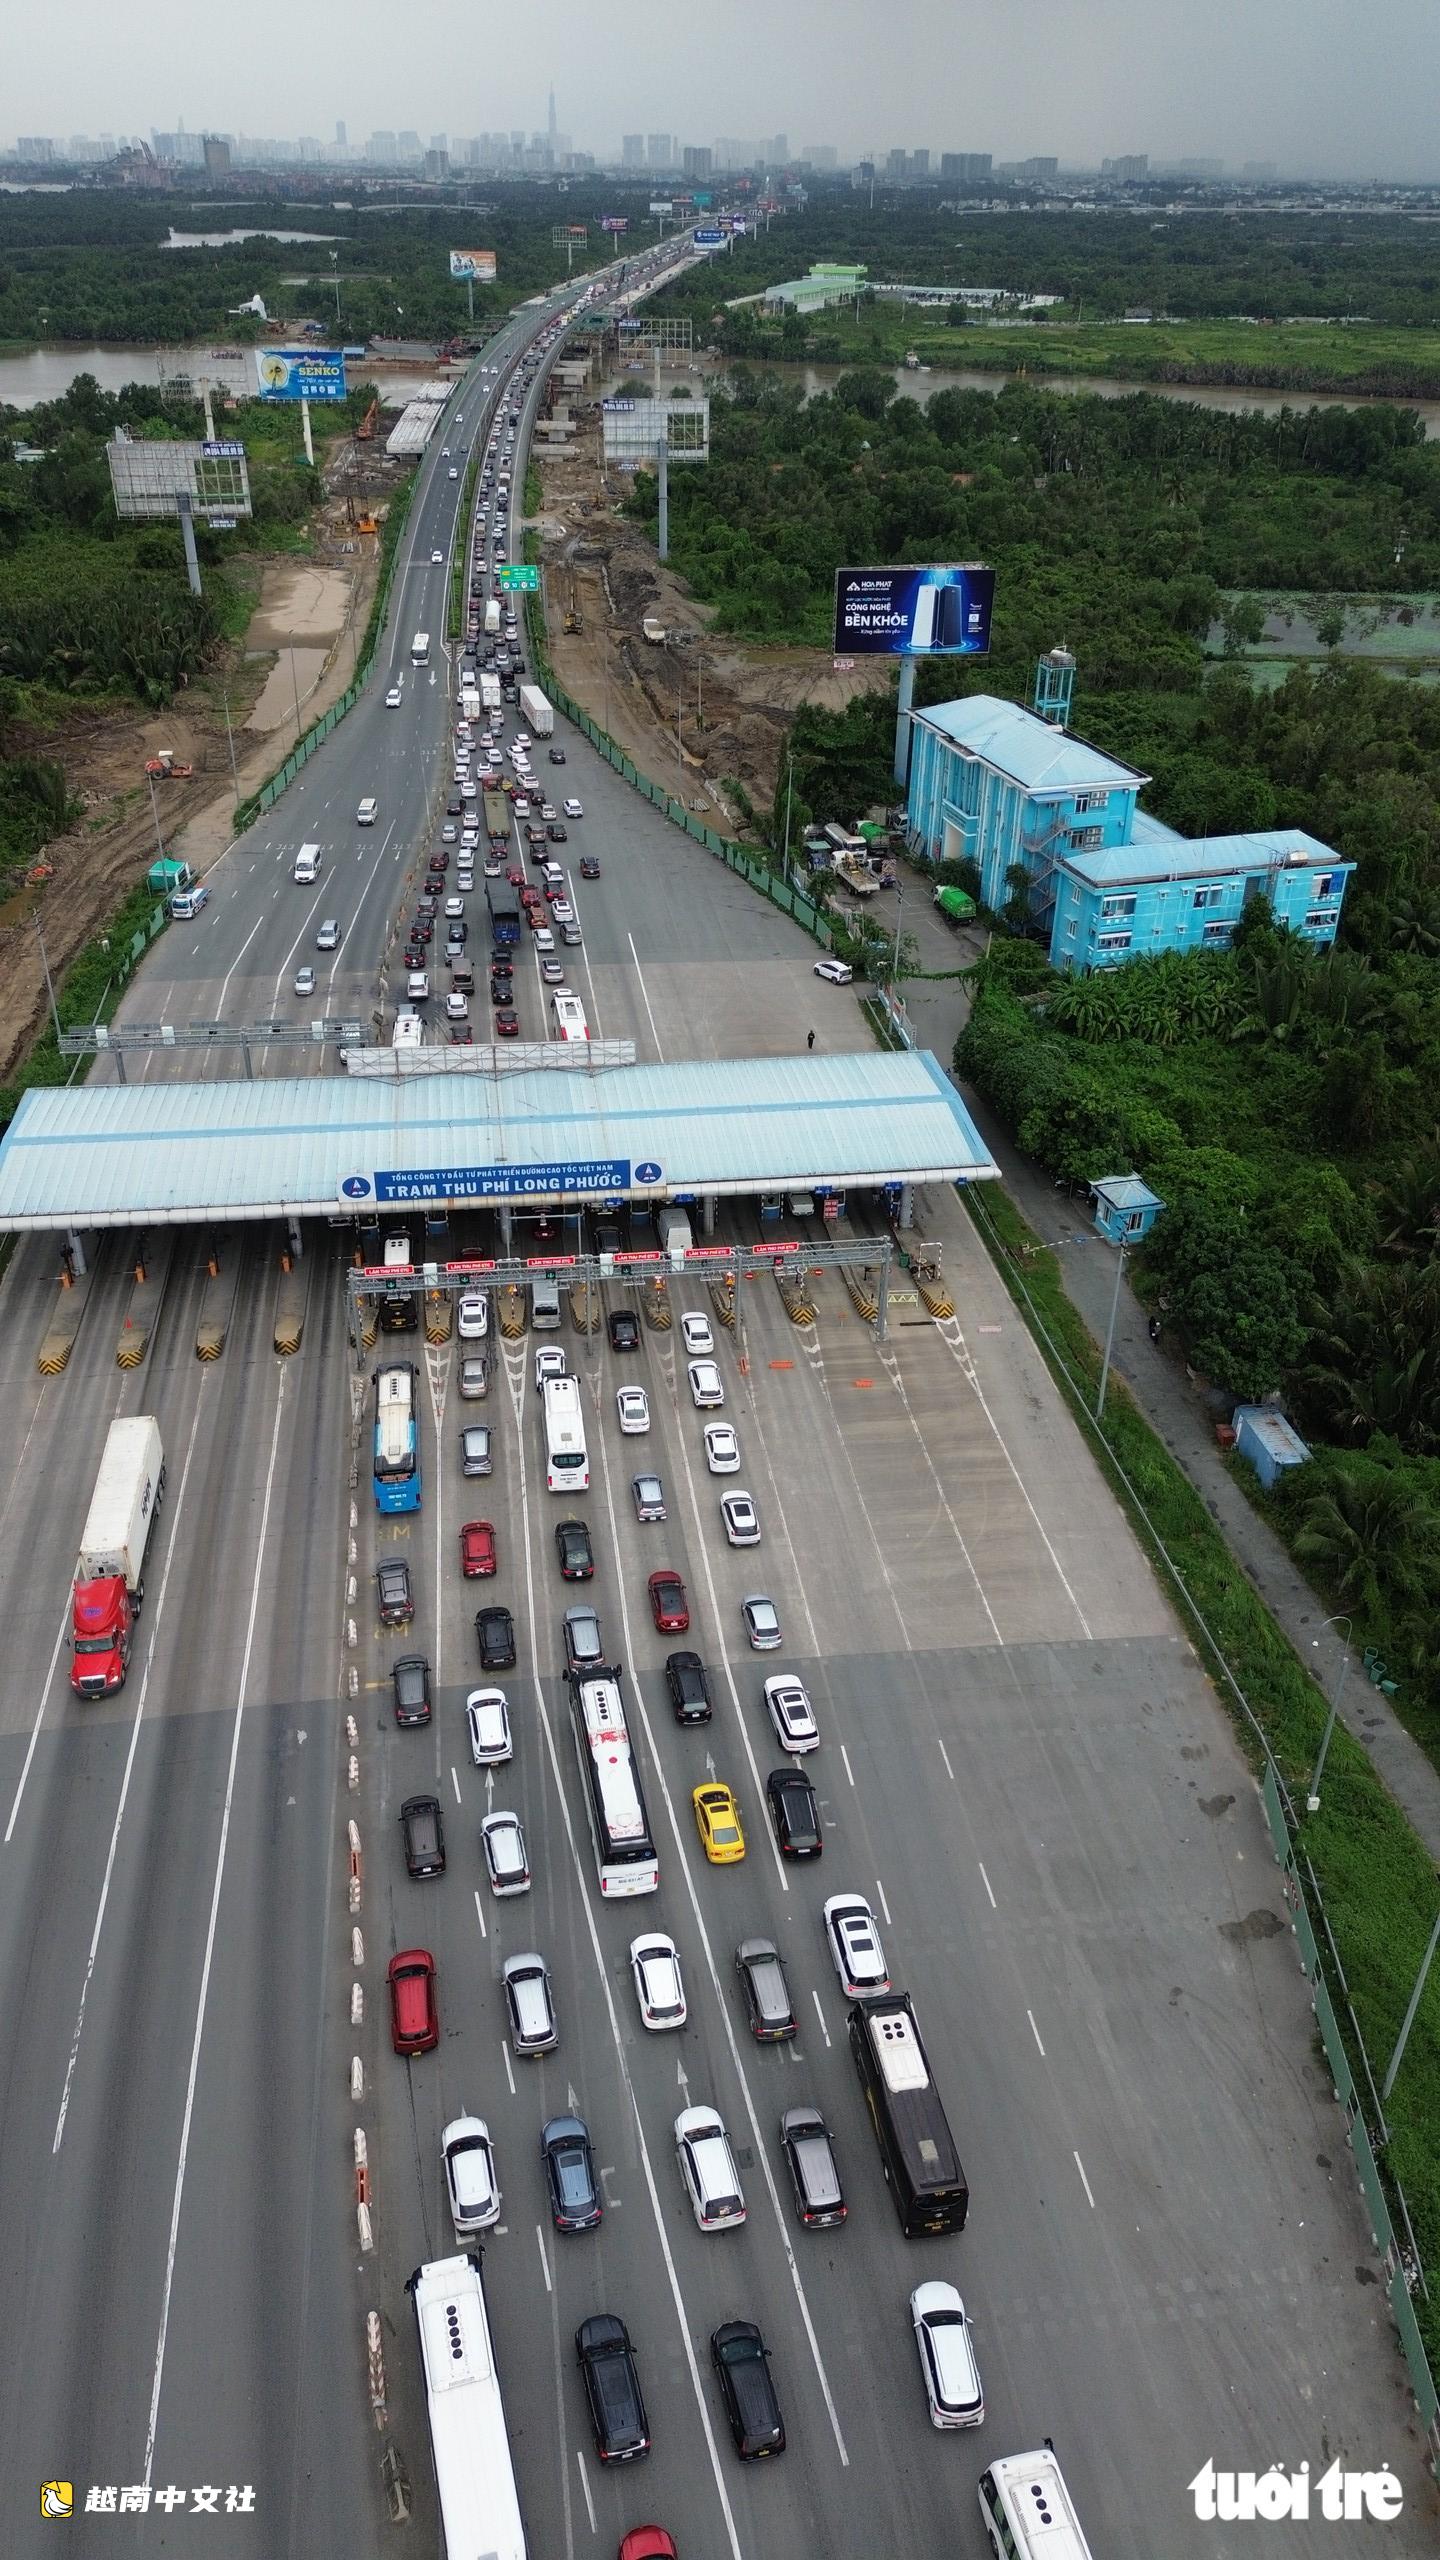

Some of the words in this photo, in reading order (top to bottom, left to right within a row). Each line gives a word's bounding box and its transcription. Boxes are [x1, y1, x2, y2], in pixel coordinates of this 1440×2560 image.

[299, 368, 340, 376] SENKO
[846, 603, 868, 611] CÔNG
[870, 602, 892, 612] NGHỆ
[844, 612, 872, 626] BỀN
[872, 612, 908, 626] KHỎE
[392, 1172, 412, 1182] TỔNG
[414, 1172, 434, 1180] CÔNG
[477, 1168, 497, 1177] PHÁT
[498, 1166, 521, 1176] TRIỂN
[562, 1165, 577, 1173] TỐC
[579, 1165, 595, 1173] VIỆT
[386, 1184, 436, 1198] TRẠM
[443, 1182, 476, 1194] THU
[482, 1176, 510, 1192] PHÍ
[514, 1178, 560, 1191] LONG
[565, 1172, 622, 1189] PHƯỚC
